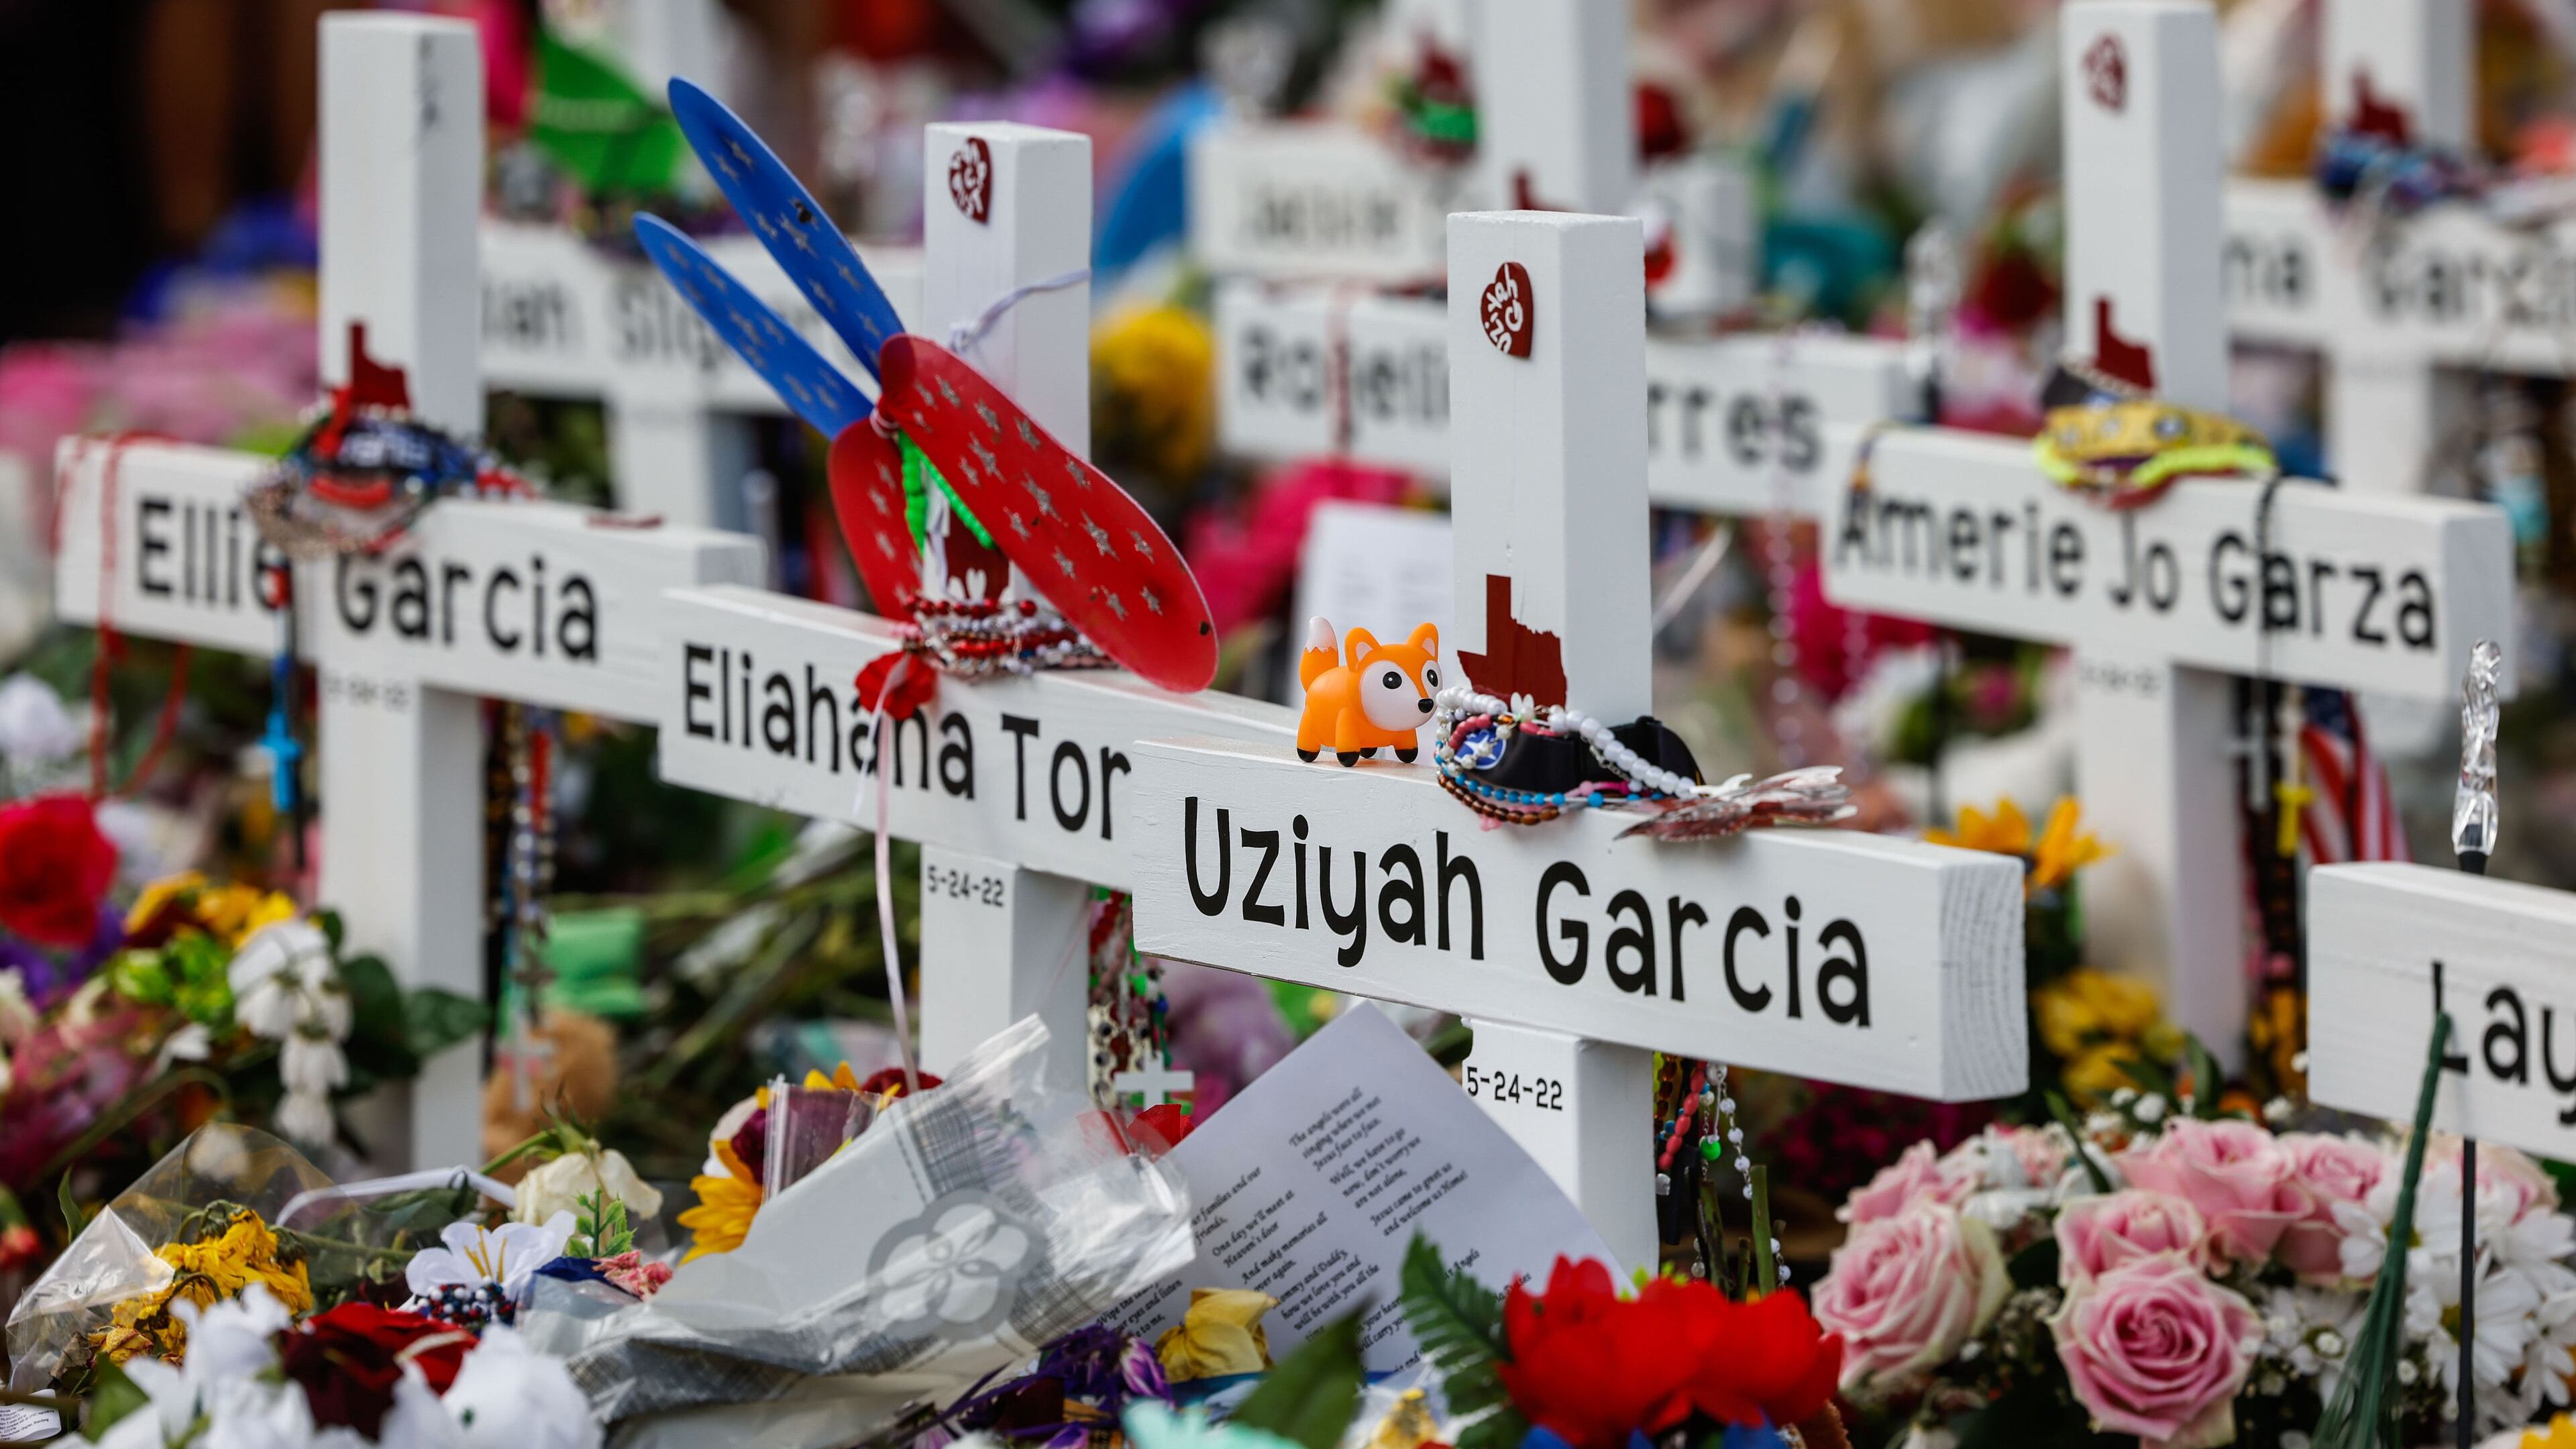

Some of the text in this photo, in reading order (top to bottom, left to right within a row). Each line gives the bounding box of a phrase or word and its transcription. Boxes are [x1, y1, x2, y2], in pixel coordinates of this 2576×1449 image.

[1833, 493, 2438, 651] Amerie Jo Garza
[335, 554, 597, 662] Garcia
[684, 642, 975, 801] Eliahana
[927, 865, 1004, 907] 5-24-22
[1184, 796, 1872, 1029] Uziyah Garcia
[1466, 1067, 1563, 1111] 5-24-22
[1289, 1085, 1363, 1146] The angels were all
[1302, 1095, 1381, 1159] singing when we met
[1313, 1150, 1336, 1172] Jesus
[1335, 1142, 1353, 1158] face
[1351, 1130, 1363, 1140] to
[1354, 1157, 1367, 1169] we
[1365, 1142, 1385, 1159] have
[1385, 1135, 1395, 1145] to
[1395, 1128, 1405, 1142] go
[1364, 1163, 1385, 1182] don't
[1384, 1144, 1410, 1165] worry
[1408, 1136, 1421, 1148] we
[1199, 1192, 1232, 1222] families
[1231, 1175, 1248, 1194] and
[1247, 1167, 1260, 1181] our
[1354, 1195, 1368, 1209] are
[1368, 1183, 1383, 1198] not
[1370, 1163, 1453, 1227] Jesus came to greet us
[1383, 1217, 1401, 1237] and
[1399, 1197, 1432, 1224] welcome
[1432, 1190, 1443, 1201] us
[1212, 1189, 1295, 1256] One day we'll meet at
[1224, 1222, 1279, 1268] Heaven's door
[1242, 1210, 1328, 1285] And make memories all
[1128, 1307, 1146, 1324] eyes
[1144, 1292, 1161, 1311] and
[1158, 1279, 1183, 1299] listen
[1254, 1275, 1272, 1293] over
[1277, 1282, 1305, 1304] ommy
[1303, 1266, 1320, 1285] and
[1281, 1254, 1362, 1320] how we love you and
[1293, 1264, 1380, 1331] will be with you all the
[1140, 1324, 1151, 1334] to
[1362, 1310, 1382, 1332] your
[1373, 1325, 1393, 1342] carry
